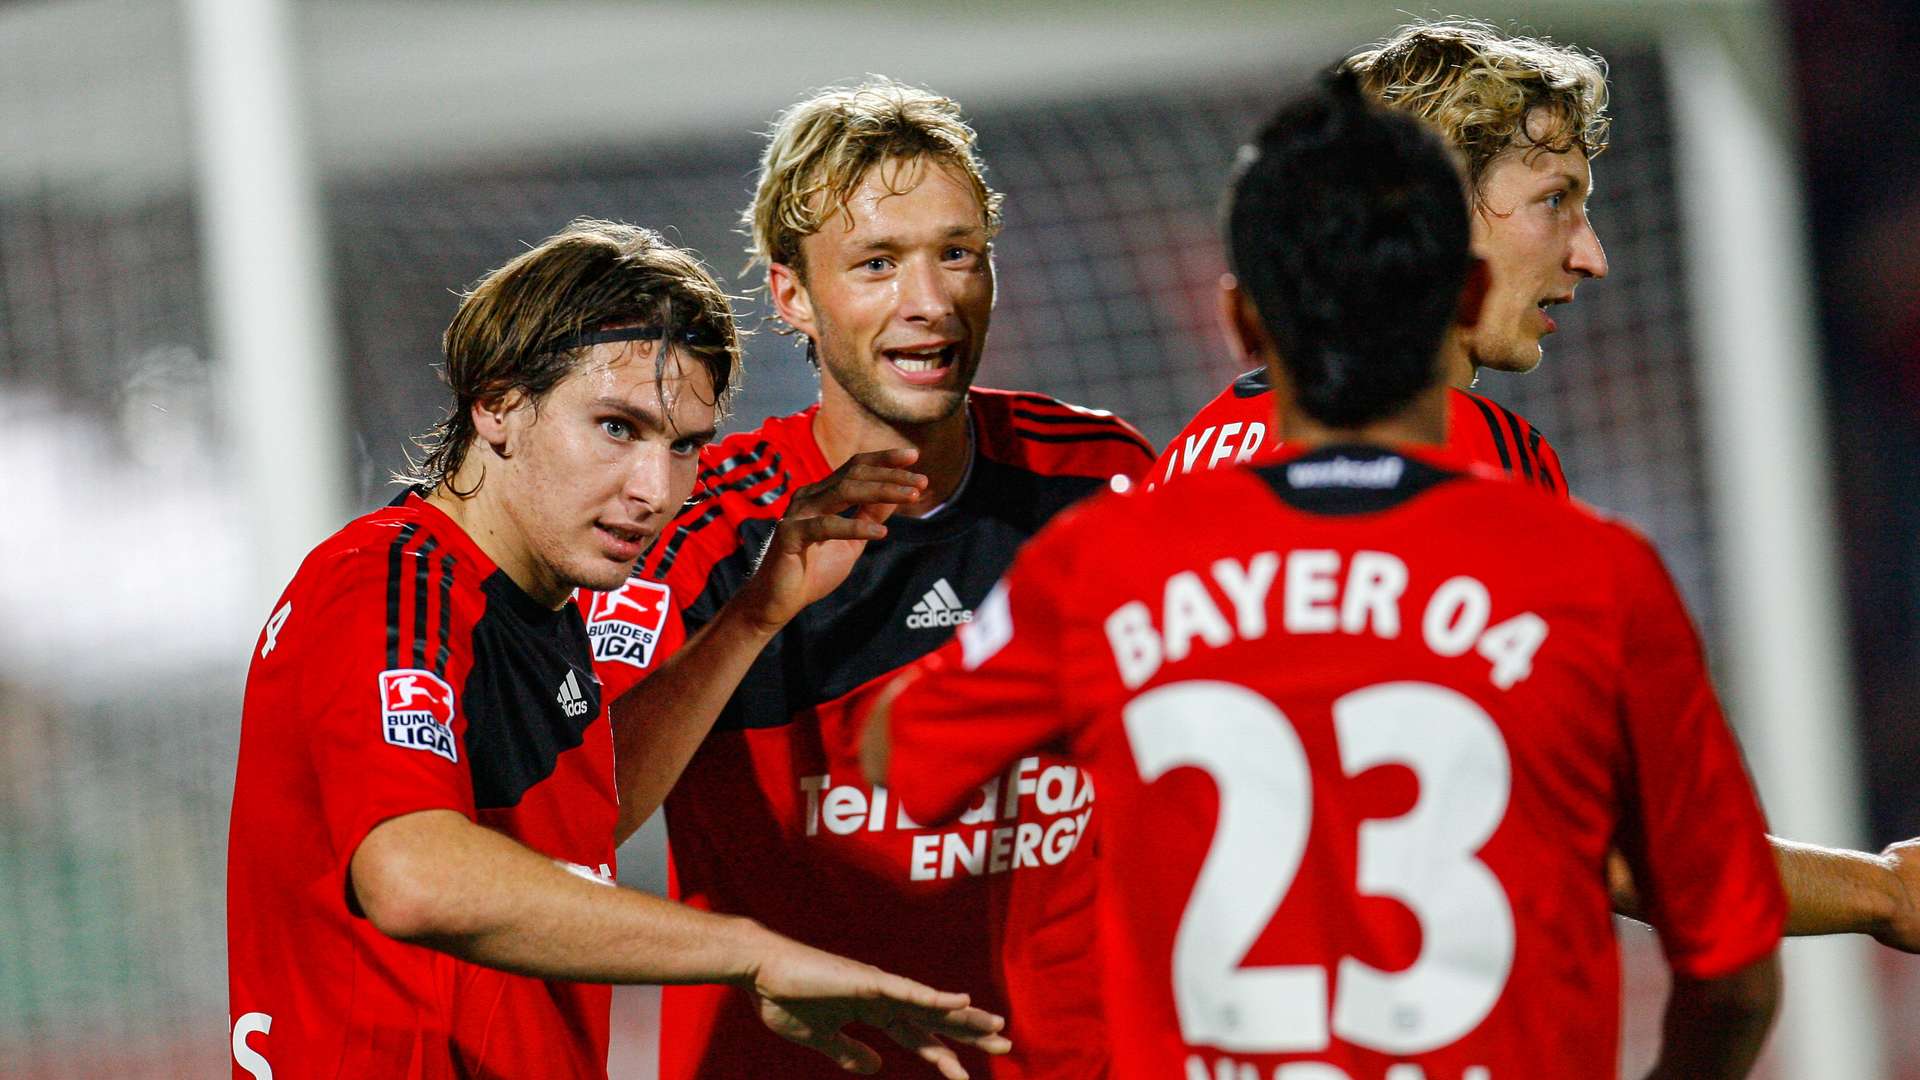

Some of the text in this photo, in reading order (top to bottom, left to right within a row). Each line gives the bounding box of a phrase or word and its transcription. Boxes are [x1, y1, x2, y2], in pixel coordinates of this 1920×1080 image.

[261, 600, 292, 660] 4
[588, 624, 654, 644] BUNDES
[906, 609, 973, 629] adidas
[1104, 549, 1549, 690] BAYER 04
[596, 636, 645, 664] IGA
[389, 726, 455, 759] LIGA
[800, 756, 1096, 836] TelaFax
[910, 807, 1092, 881] ENERGY
[1122, 679, 1516, 1056] 23
